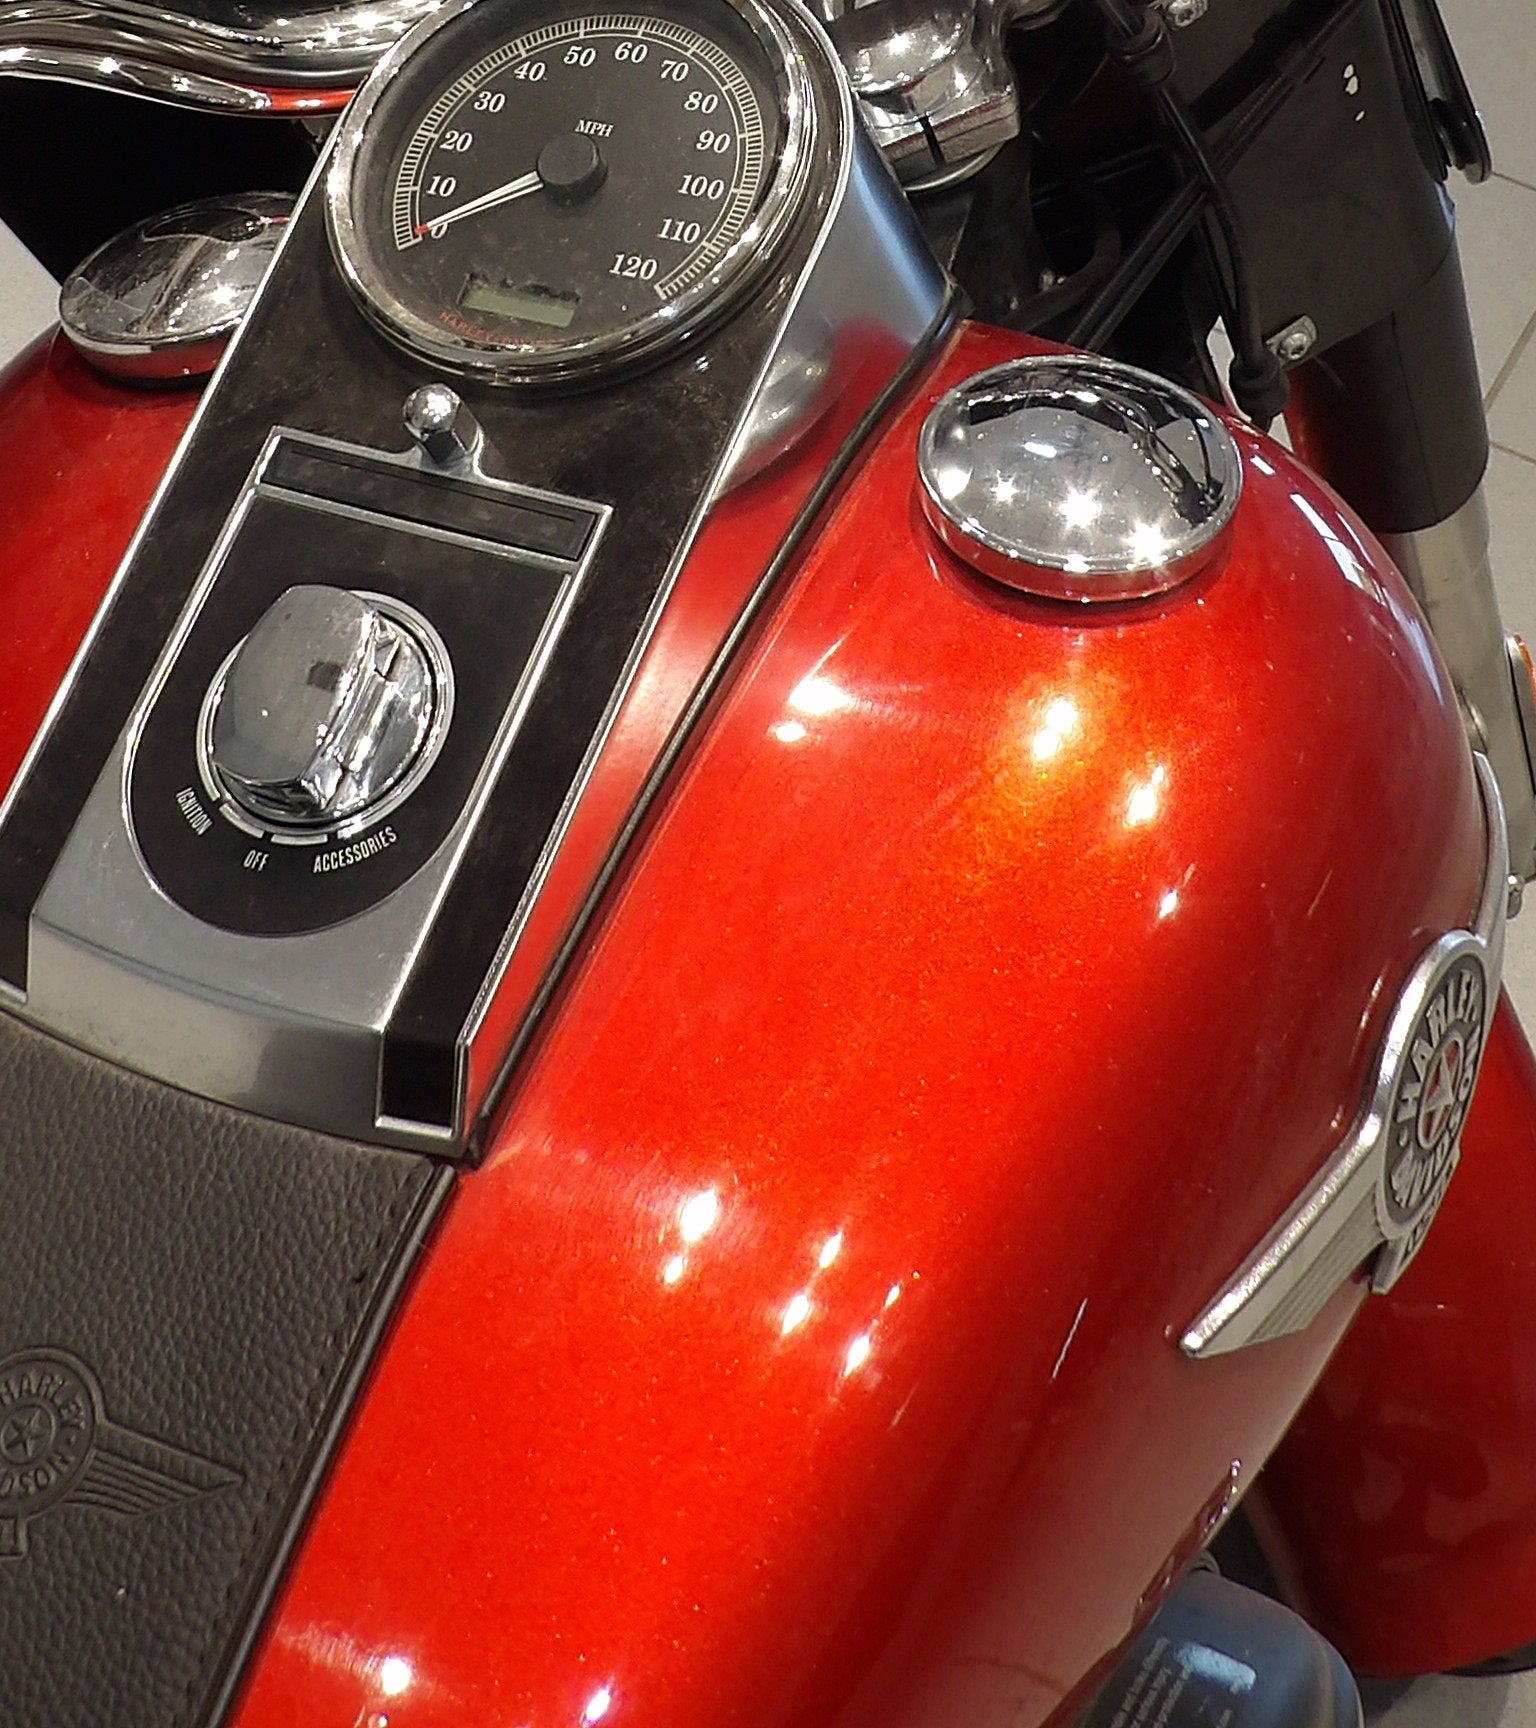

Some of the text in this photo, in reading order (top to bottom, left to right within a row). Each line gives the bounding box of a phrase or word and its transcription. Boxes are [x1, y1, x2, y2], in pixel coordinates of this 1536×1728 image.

[563, 45, 596, 67] 50
[614, 41, 648, 64] 60
[514, 61, 546, 82] 40
[660, 59, 689, 82] 70
[474, 90, 506, 113] 30
[684, 91, 718, 114] 80
[574, 119, 614, 138] MPH
[440, 130, 473, 152] 20
[696, 130, 731, 154] 90
[426, 175, 456, 198] 10
[678, 174, 725, 200] 100
[430, 222, 449, 239] 0
[656, 218, 701, 244] 110
[609, 253, 657, 280] 120
[175, 786, 213, 837] IGNITION
[243, 849, 270, 872] OFF
[313, 826, 398, 873] ACCESSORIES
[1395, 968, 1481, 1123] HARLEY
